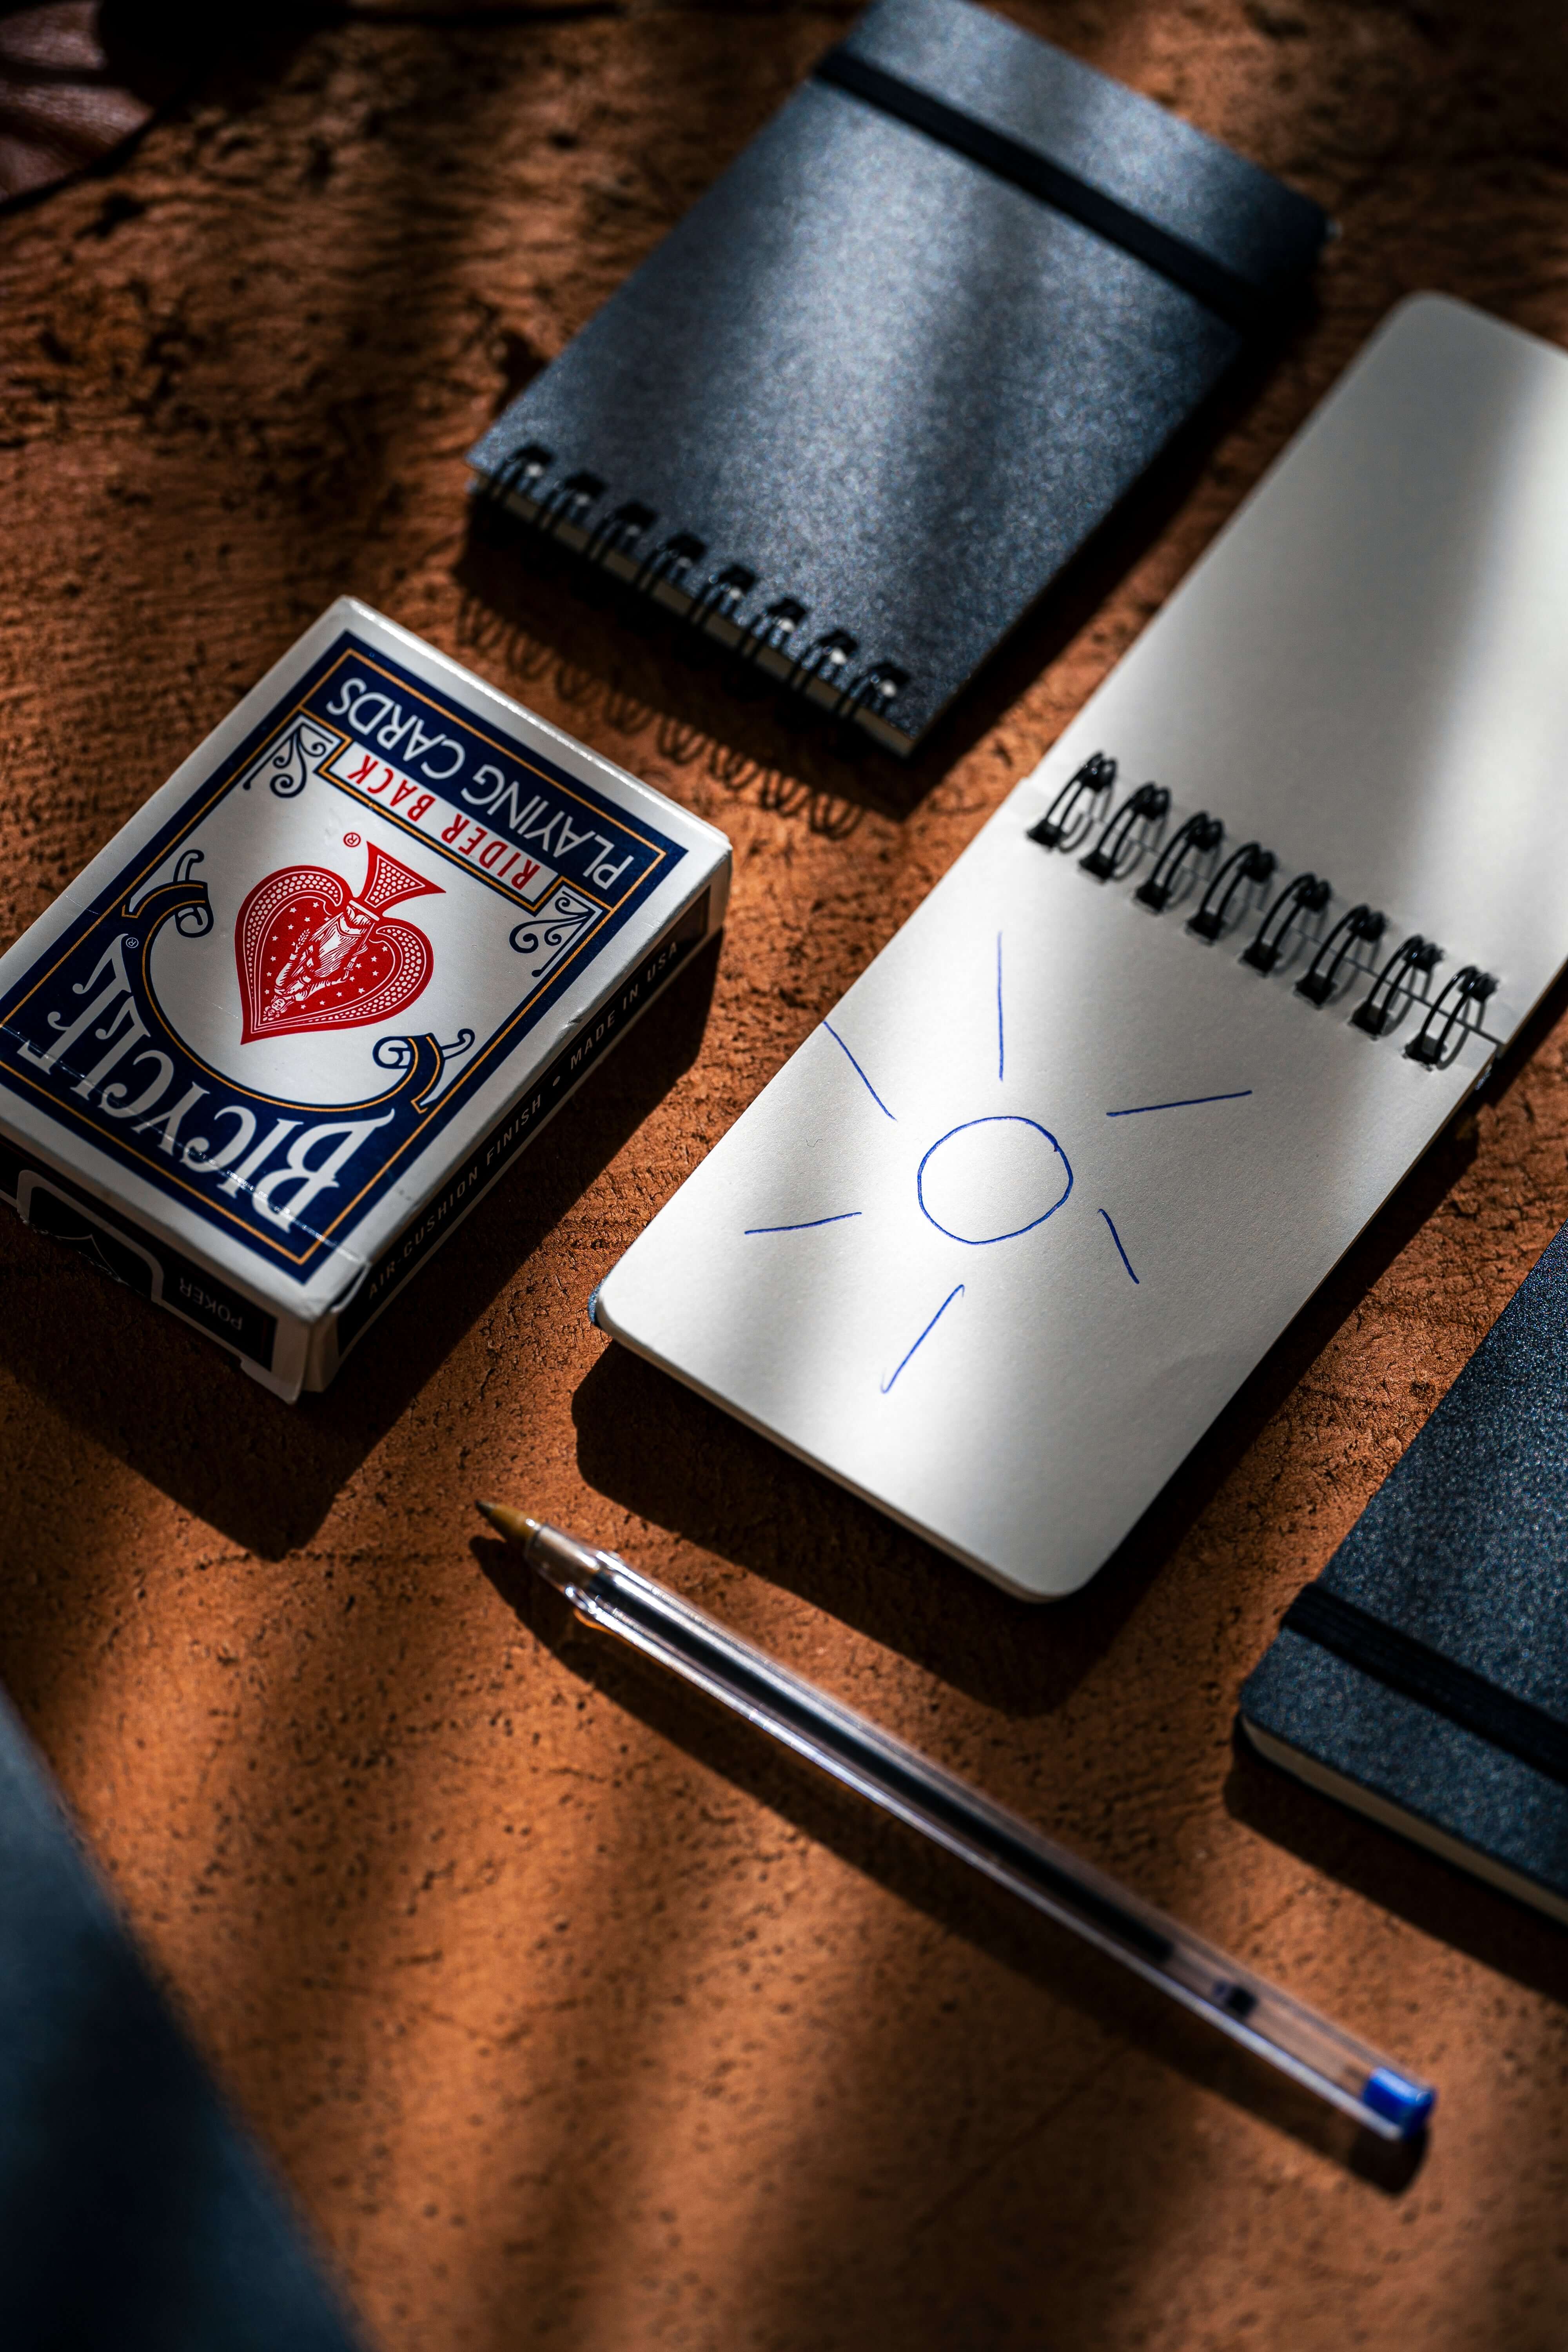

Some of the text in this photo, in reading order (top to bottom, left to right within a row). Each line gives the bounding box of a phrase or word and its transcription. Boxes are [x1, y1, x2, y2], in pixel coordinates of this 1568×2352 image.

[326, 677, 634, 890] PLAYING CARDS
[347, 755, 539, 891] RIDER BACK
[16, 933, 395, 1233] BICYCLE
[368, 941, 677, 1299] AIR-CUSHION FINISH MADE IN USA
[179, 1277, 243, 1330] POKER
